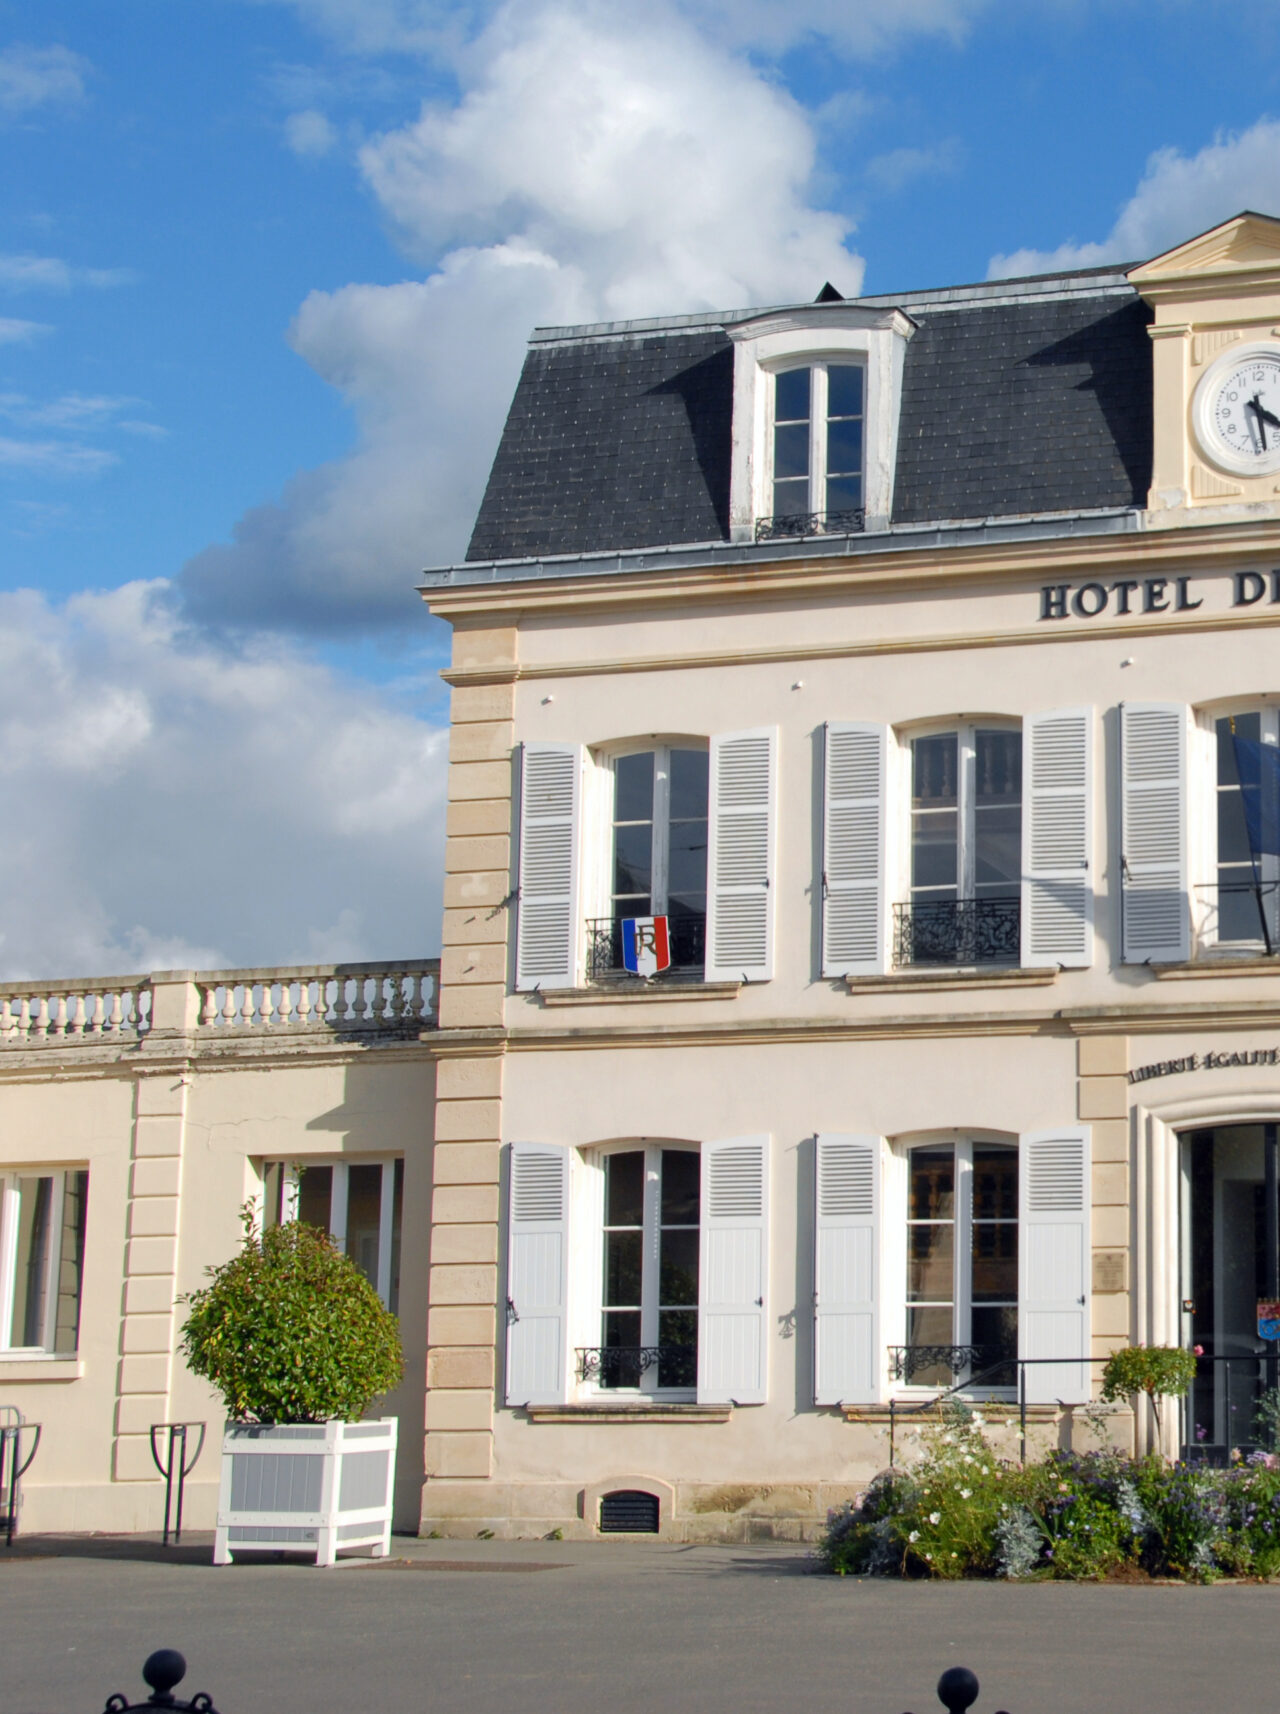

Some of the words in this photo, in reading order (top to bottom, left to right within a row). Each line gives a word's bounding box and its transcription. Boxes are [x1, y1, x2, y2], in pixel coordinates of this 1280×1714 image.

[1252, 370, 1265, 381] 12
[1238, 377, 1247, 388] 11
[1226, 391, 1238, 402] 10
[1222, 408, 1231, 418] 9
[1227, 424, 1237, 434] 8
[1241, 435, 1250, 445] 7
[1038, 576, 1203, 621] HOTEL
